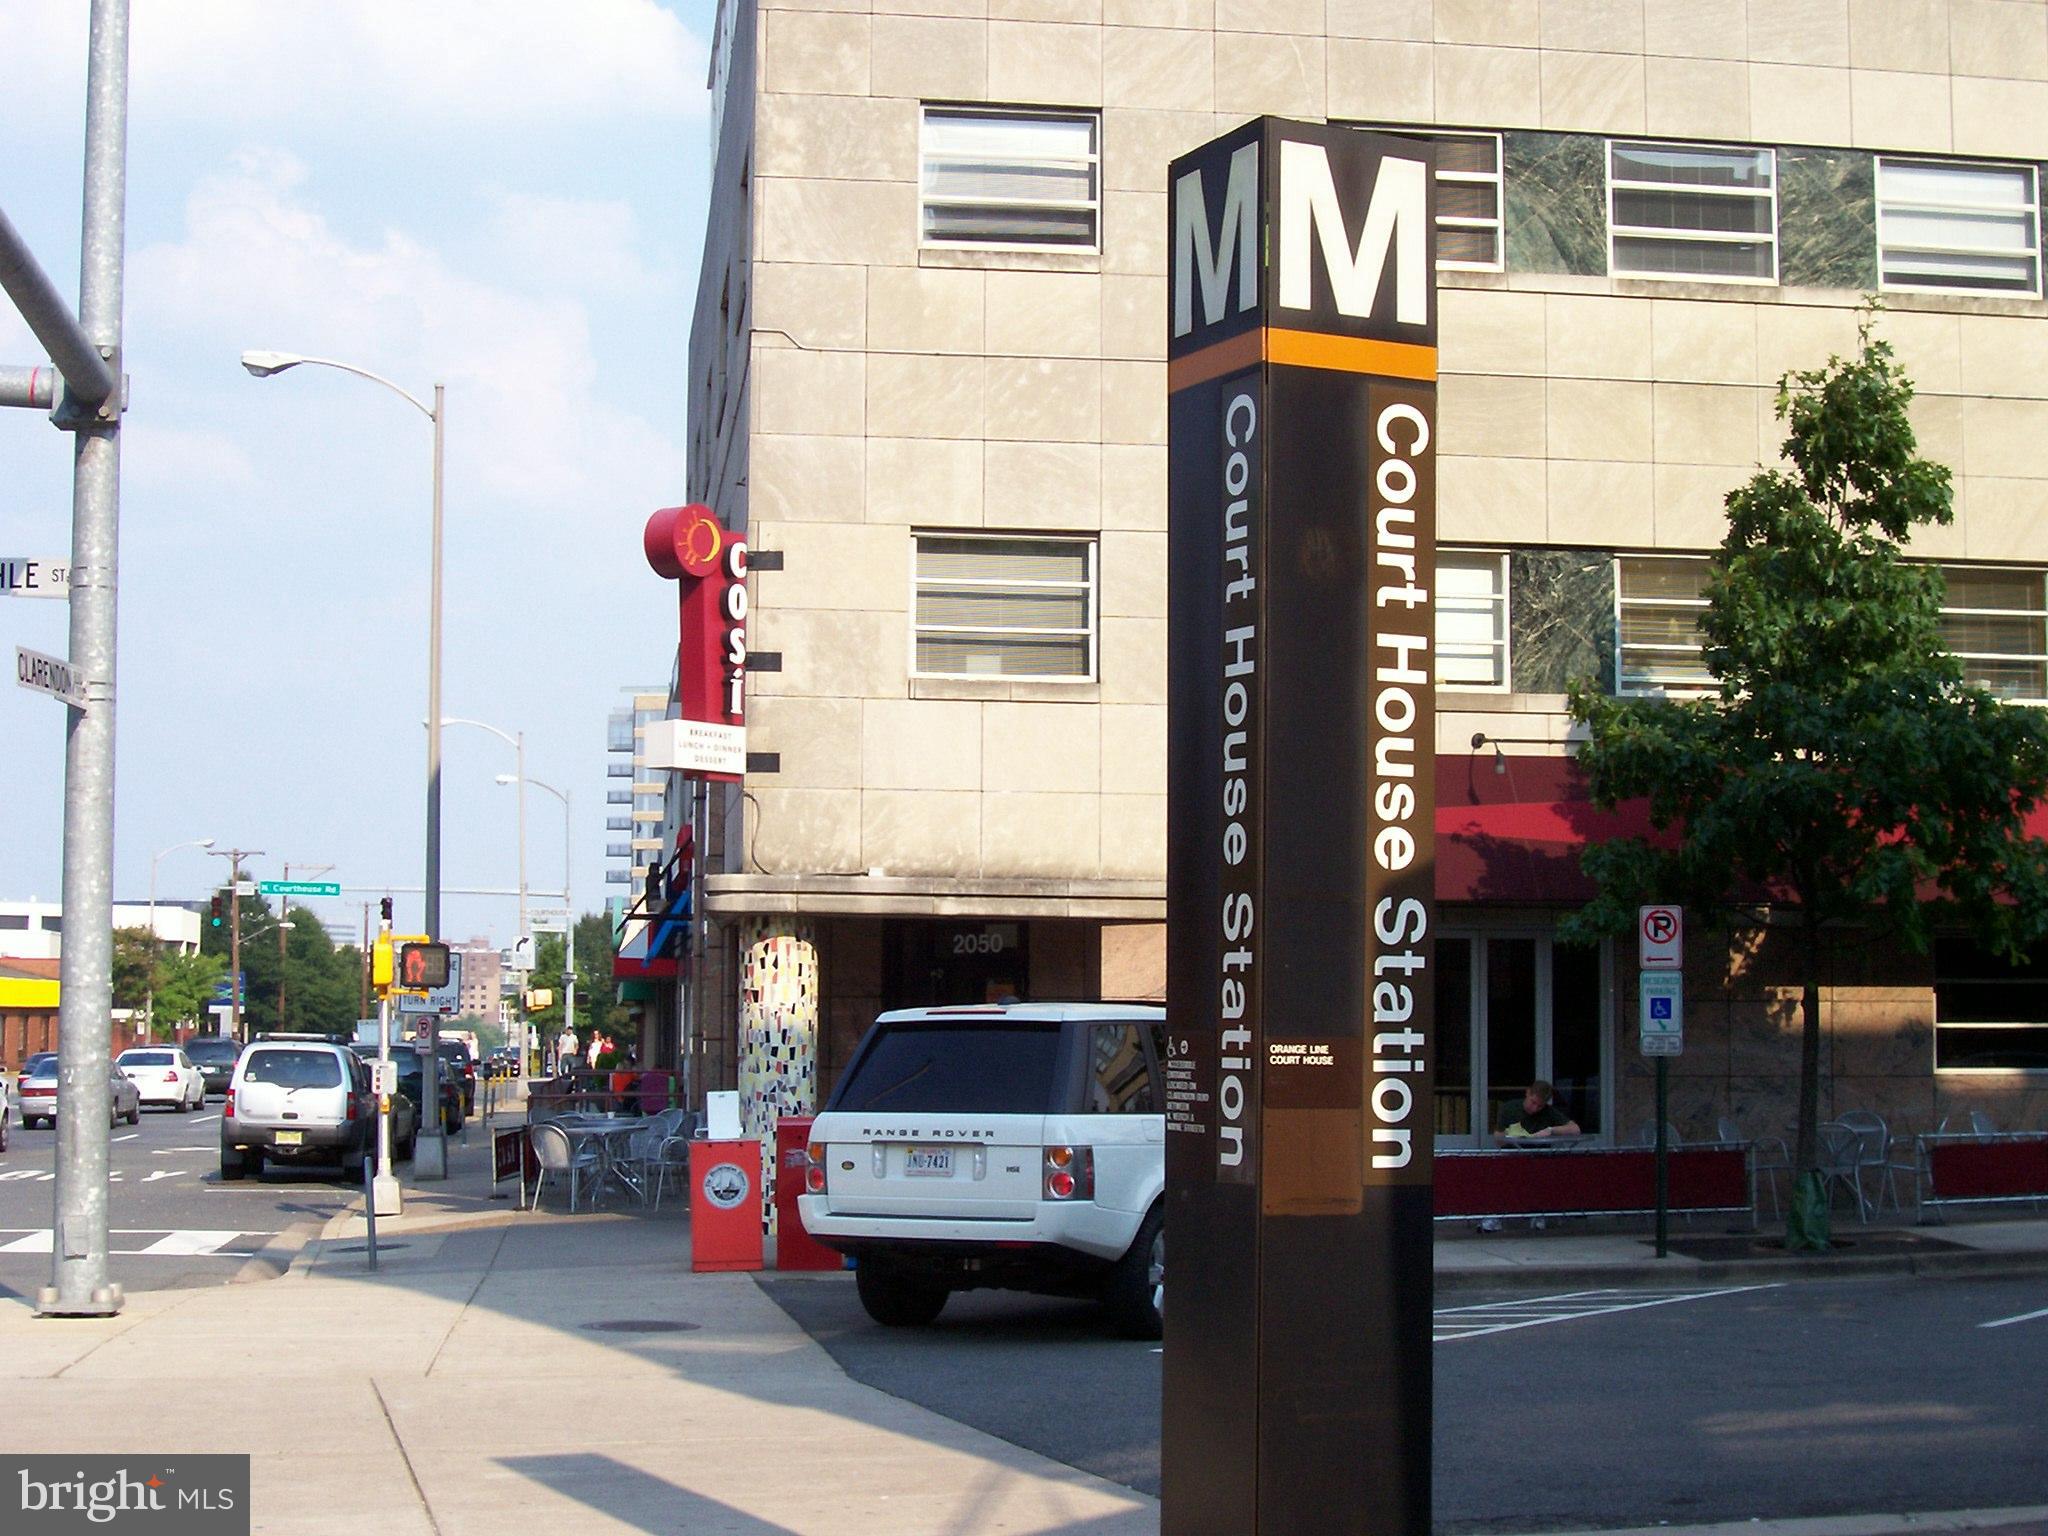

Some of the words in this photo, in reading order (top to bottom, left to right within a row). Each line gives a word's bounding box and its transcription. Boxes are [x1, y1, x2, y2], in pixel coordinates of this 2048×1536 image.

[1174, 141, 1258, 339] M
[1280, 139, 1427, 326] M
[1224, 392, 1257, 604] Court
[1375, 402, 1431, 609] Court
[18, 652, 73, 696] CLARENDON
[1222, 625, 1255, 866] House
[1373, 632, 1428, 871] House
[273, 884, 322, 893] Courthouse
[324, 885, 337, 894] Rd
[953, 934, 1004, 954] 2050
[402, 995, 426, 1005] TURN
[430, 996, 457, 1006] RIGHT
[1219, 892, 1254, 1168] Station
[1269, 1044, 1307, 1054] ORANGE
[1309, 1045, 1329, 1055] LINE
[1269, 1055, 1301, 1065] COURT
[1302, 1056, 1334, 1066] HOUSE
[1371, 895, 1428, 1170] Station
[862, 1128, 920, 1137] RANGE
[932, 1130, 995, 1138] ROVER
